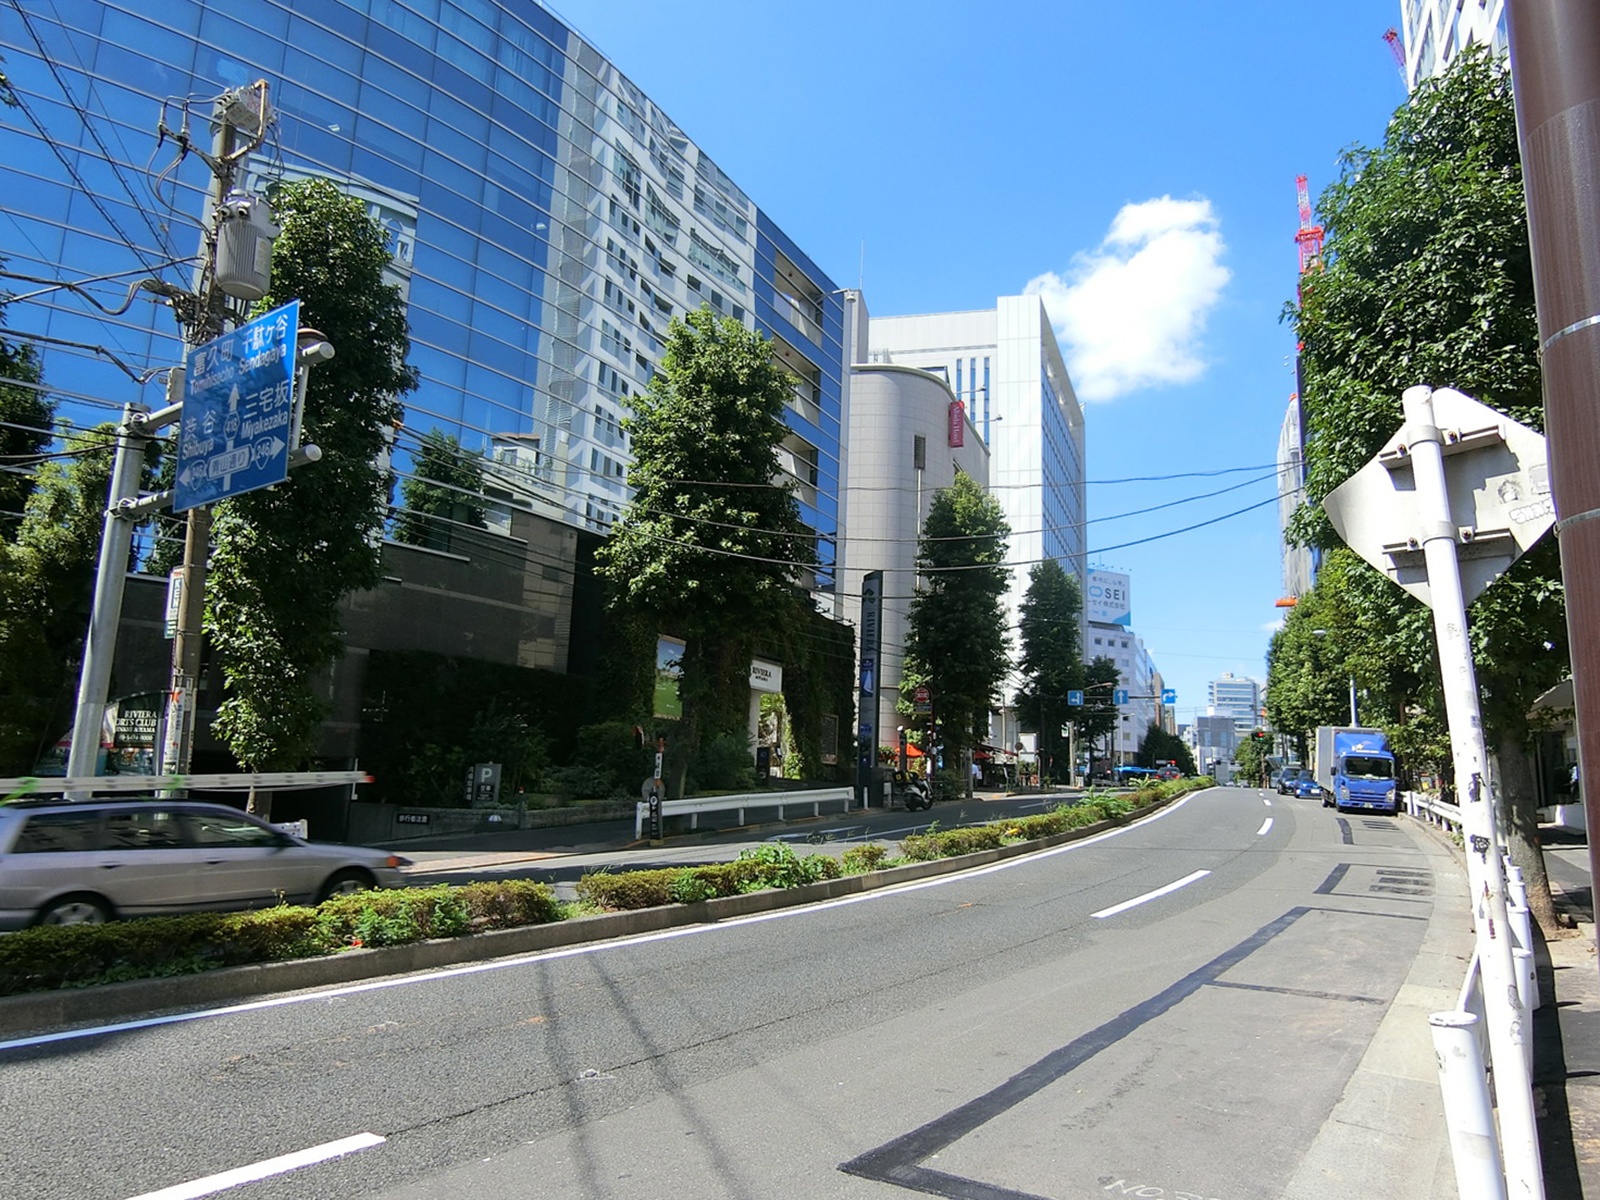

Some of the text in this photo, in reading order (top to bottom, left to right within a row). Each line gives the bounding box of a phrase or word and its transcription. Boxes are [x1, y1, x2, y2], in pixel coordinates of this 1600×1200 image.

[194, 339, 234, 376] 富久町
[239, 343, 287, 374] Sendagaya
[244, 381, 289, 419] 三宅坂
[184, 411, 216, 441] 渋谷
[241, 410, 287, 440] Miyakezaka
[182, 438, 214, 460] Shibuya
[256, 442, 270, 459] 246
[212, 451, 247, 475] 青山通り
[1087, 599, 1125, 610] ーセイ株式会社
[866, 611, 876, 652] RIVIERA
[752, 666, 772, 678] RIVIERA
[116, 718, 157, 727] ORTS CLUB
[125, 710, 157, 719] RIVIERA
[481, 768, 493, 783] P
